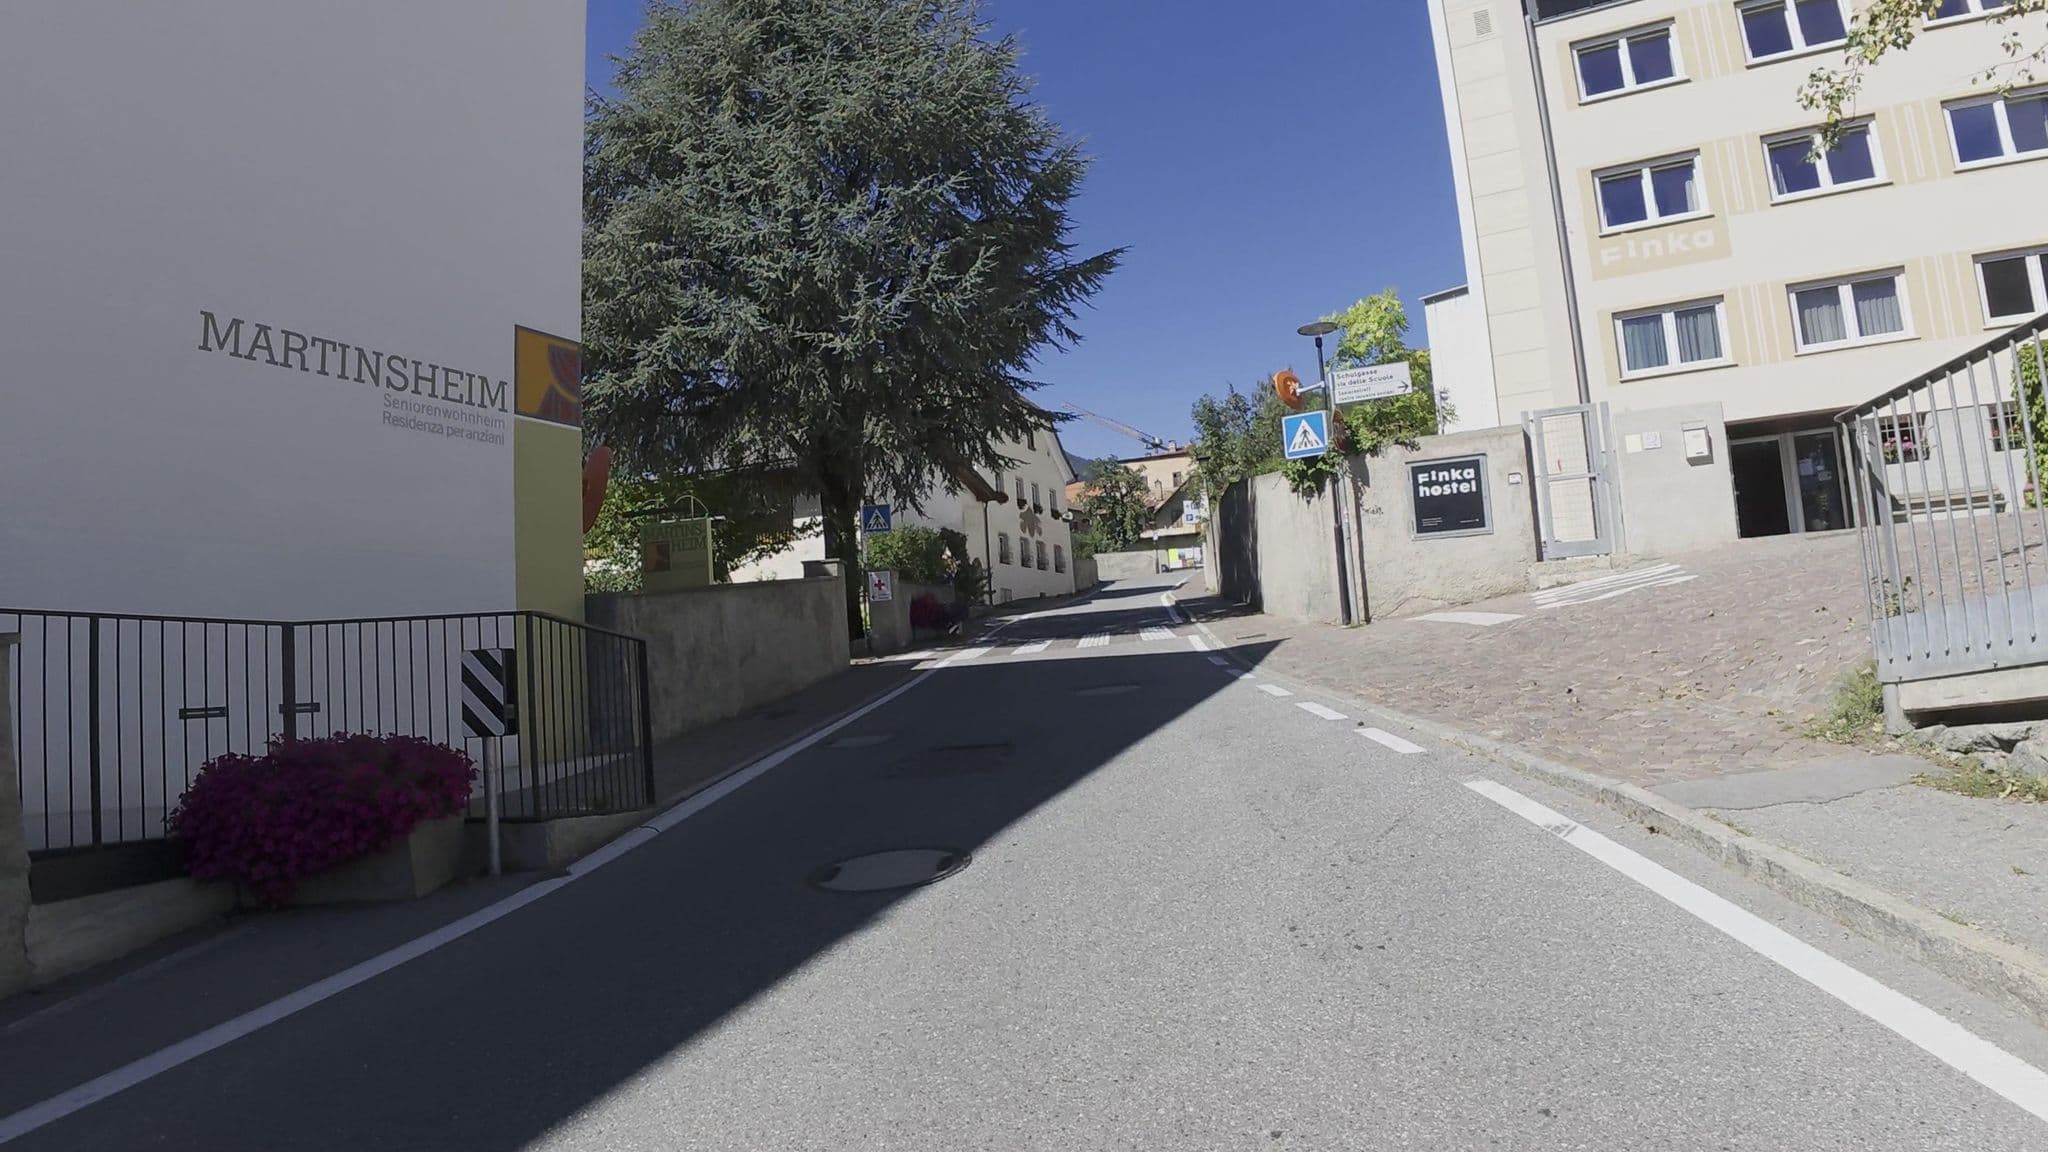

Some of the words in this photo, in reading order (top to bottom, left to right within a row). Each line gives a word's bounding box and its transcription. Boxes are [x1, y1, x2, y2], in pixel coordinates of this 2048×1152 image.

[1600, 229, 1714, 266] Finka
[198, 310, 508, 412] MARTINSHEIM
[383, 411, 443, 434] Residenza
[446, 426, 464, 439] per
[466, 428, 504, 445] anziani
[384, 393, 505, 429] Seniorenwohnheim
[1417, 468, 1475, 484] Finka
[1418, 480, 1476, 497] hostel
